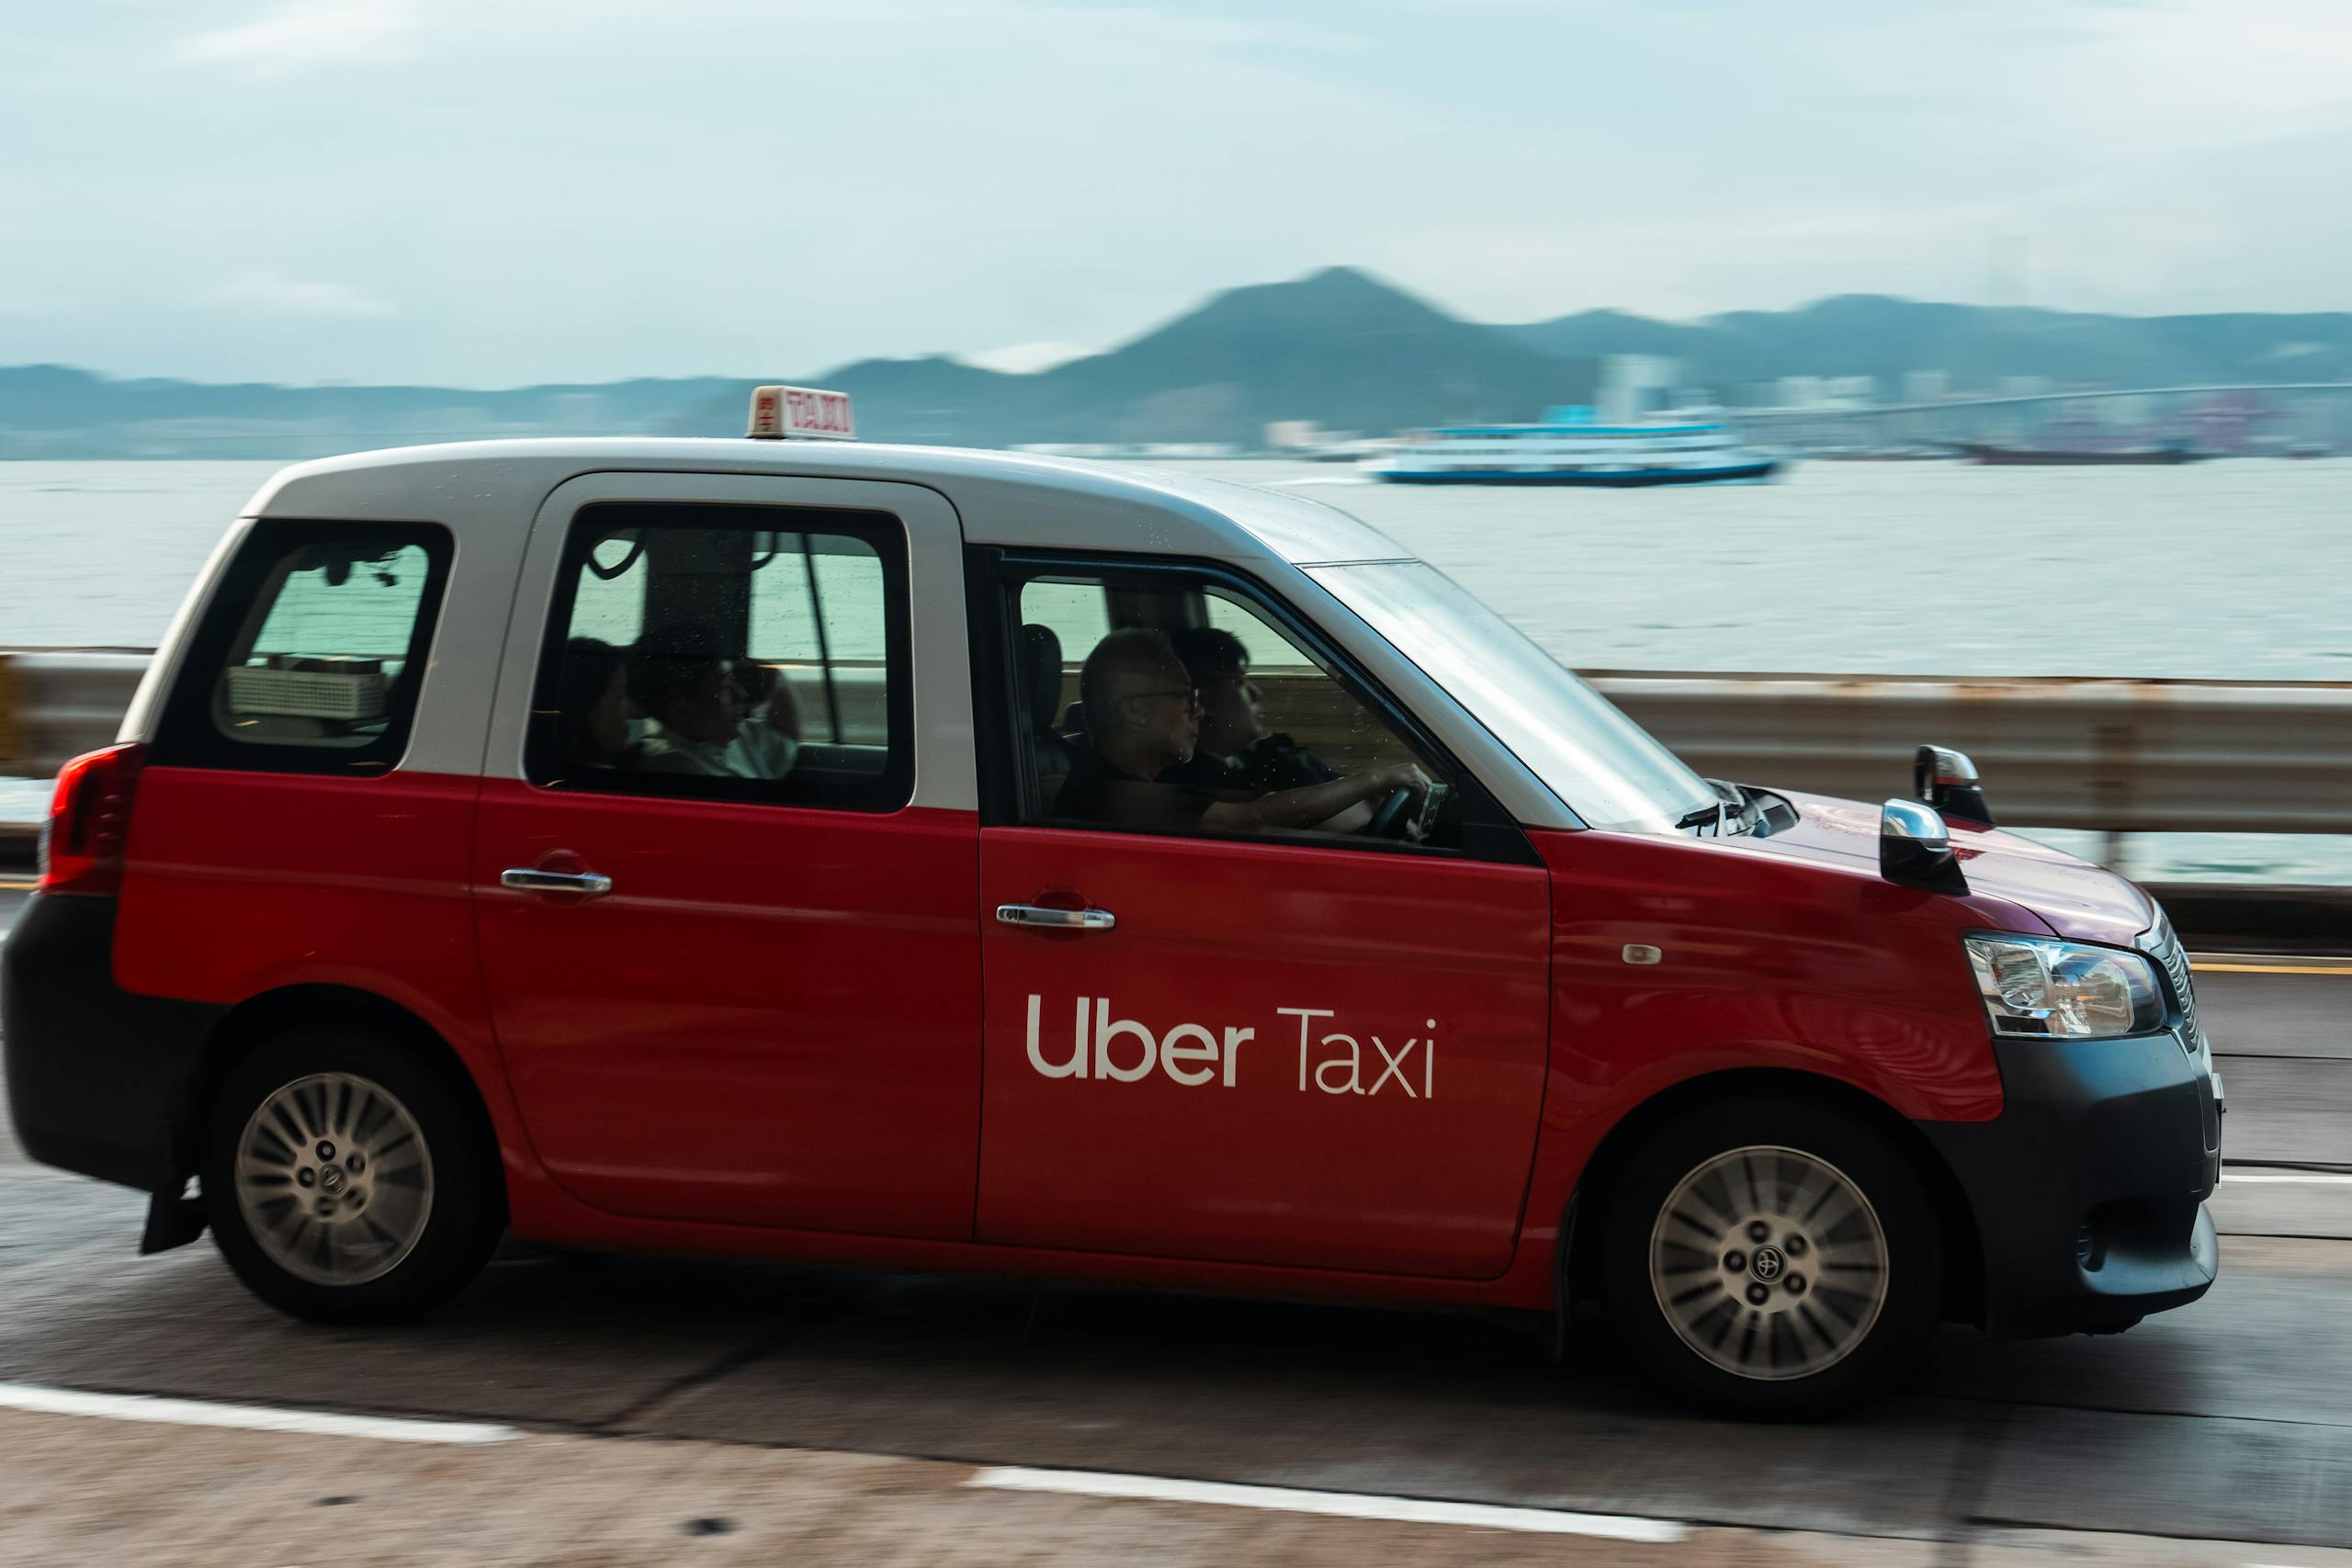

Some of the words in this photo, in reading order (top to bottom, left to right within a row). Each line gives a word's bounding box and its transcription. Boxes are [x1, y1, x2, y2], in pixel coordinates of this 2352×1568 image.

[786, 391, 850, 432] TAXI
[1026, 994, 1255, 1088] Uber
[1276, 1007, 1436, 1099] Taxi
